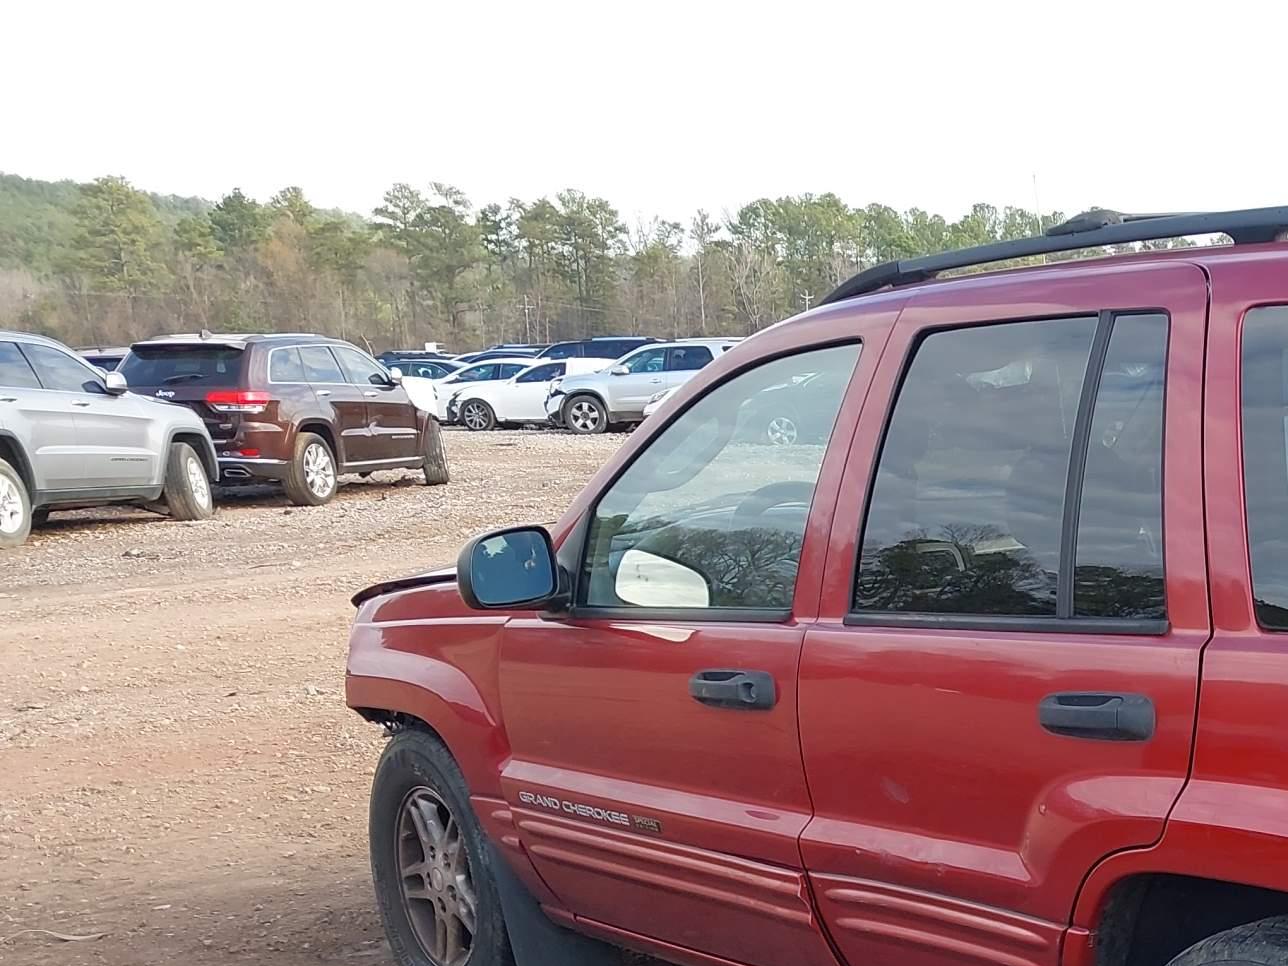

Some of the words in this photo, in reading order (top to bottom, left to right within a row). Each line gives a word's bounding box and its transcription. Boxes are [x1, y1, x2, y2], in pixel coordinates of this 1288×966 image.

[155, 389, 175, 398] Jeep
[518, 791, 560, 809] GRAND
[562, 801, 630, 826] CHEROKEE
